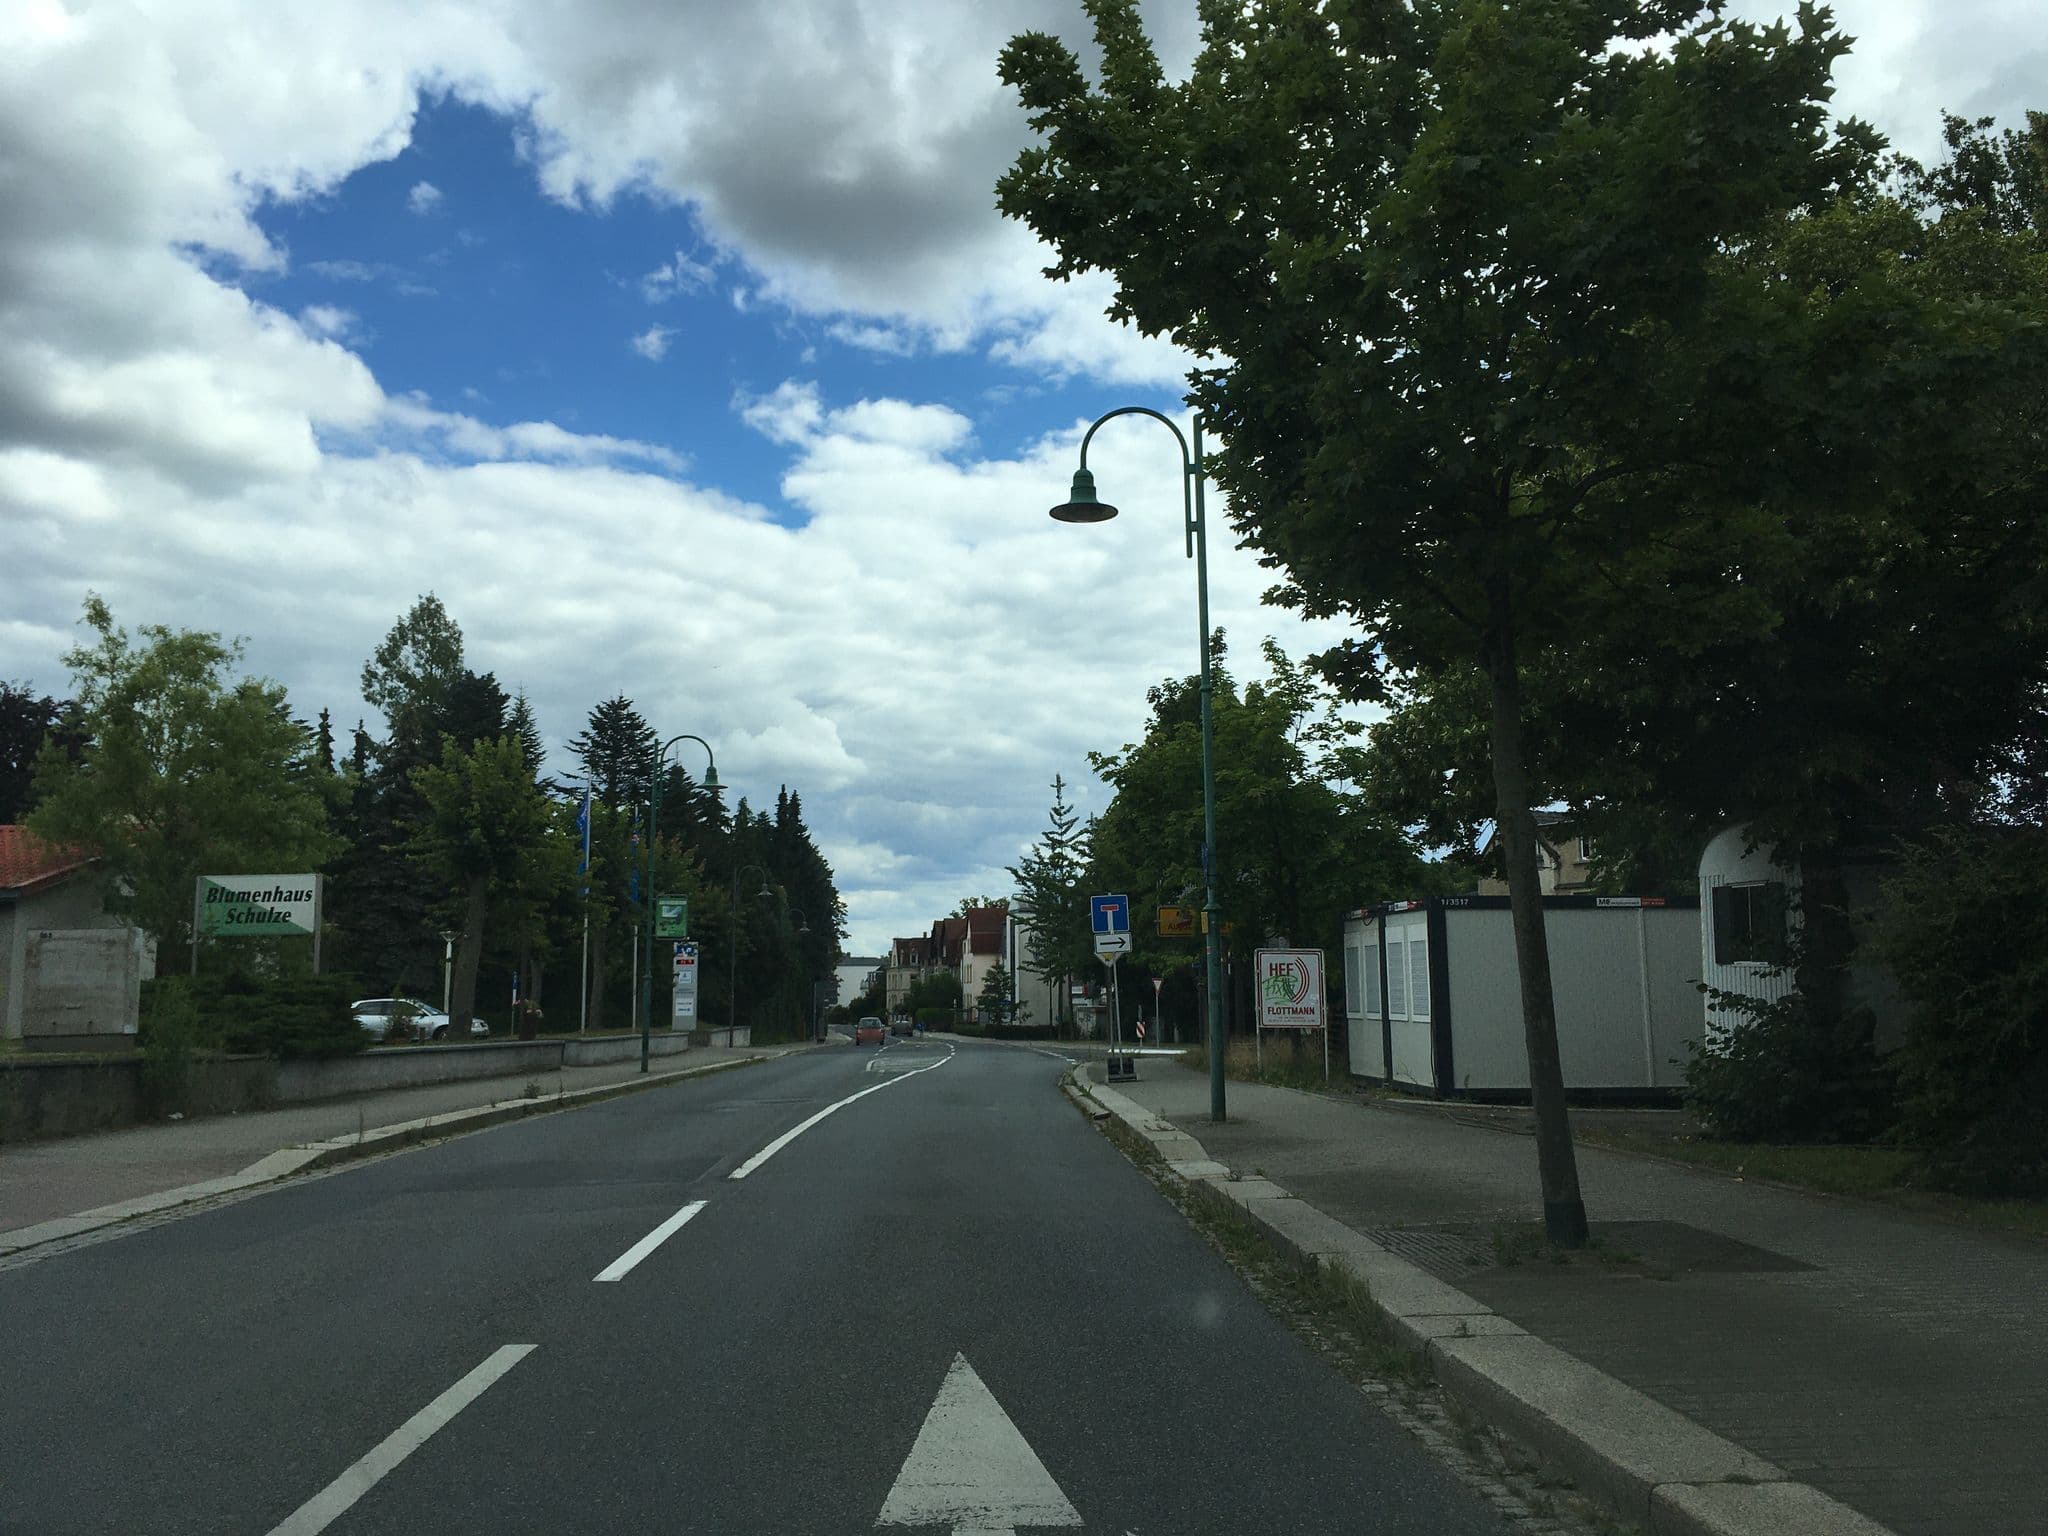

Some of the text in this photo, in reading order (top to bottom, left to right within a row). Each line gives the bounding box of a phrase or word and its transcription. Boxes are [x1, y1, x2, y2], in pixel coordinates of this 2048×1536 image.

[206, 886, 313, 903] Blumenhaus
[225, 907, 292, 924] Schulze
[1269, 963, 1294, 977] HEF
[1267, 1006, 1315, 1015] FLOTTMANN
